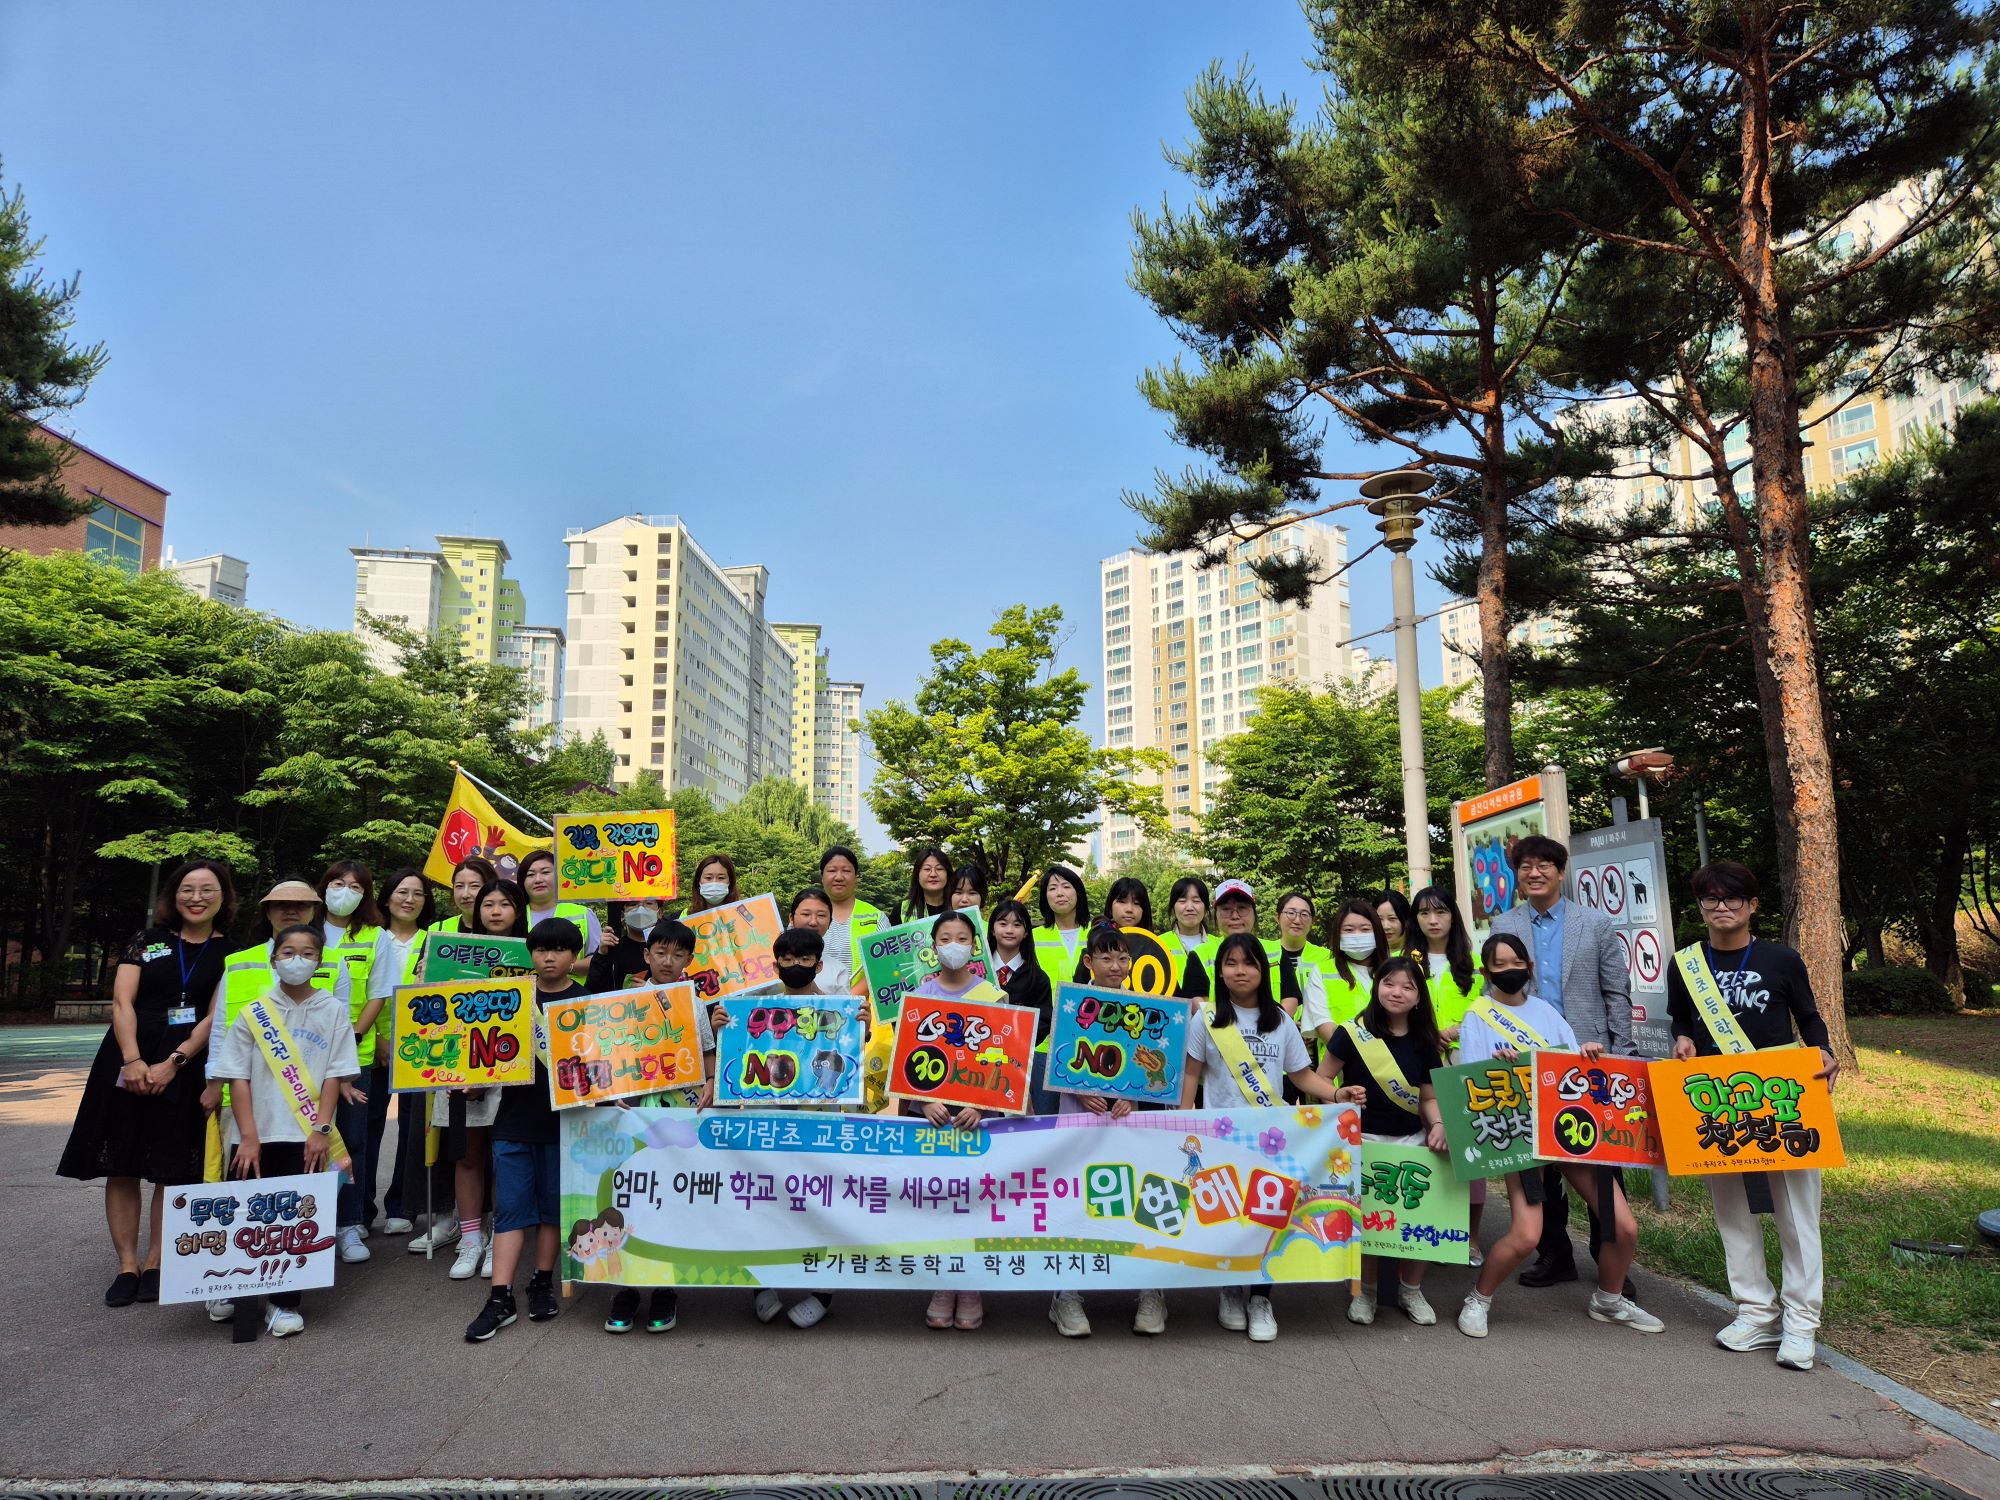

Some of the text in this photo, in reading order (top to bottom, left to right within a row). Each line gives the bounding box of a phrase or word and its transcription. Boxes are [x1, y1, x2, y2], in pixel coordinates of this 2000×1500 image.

[250, 1001, 291, 1061] 교통안전
[293, 1029, 328, 1051] STUDIO
[916, 1010, 992, 1052] 스쿨존
[1488, 1008, 1542, 1048] 교통안
[911, 1050, 945, 1082] 30
[1557, 1066, 1637, 1109] 스쿨존
[709, 1119, 982, 1155] 한가람초 교통안전 캠페인
[1559, 1112, 1595, 1147] 30
[1696, 1112, 1820, 1158] 천천히
[613, 1169, 662, 1210] 엄마,
[673, 1170, 723, 1205] 아빠
[730, 1170, 778, 1211] 학교
[785, 1173, 833, 1213] 앞에
[841, 1174, 891, 1213] 차를
[898, 1176, 971, 1214] 세우면
[978, 1167, 1080, 1232] 친구들이
[175, 1230, 228, 1256] 하면
[802, 1253, 1111, 1276] 한가람초등학교 학생 자치회
